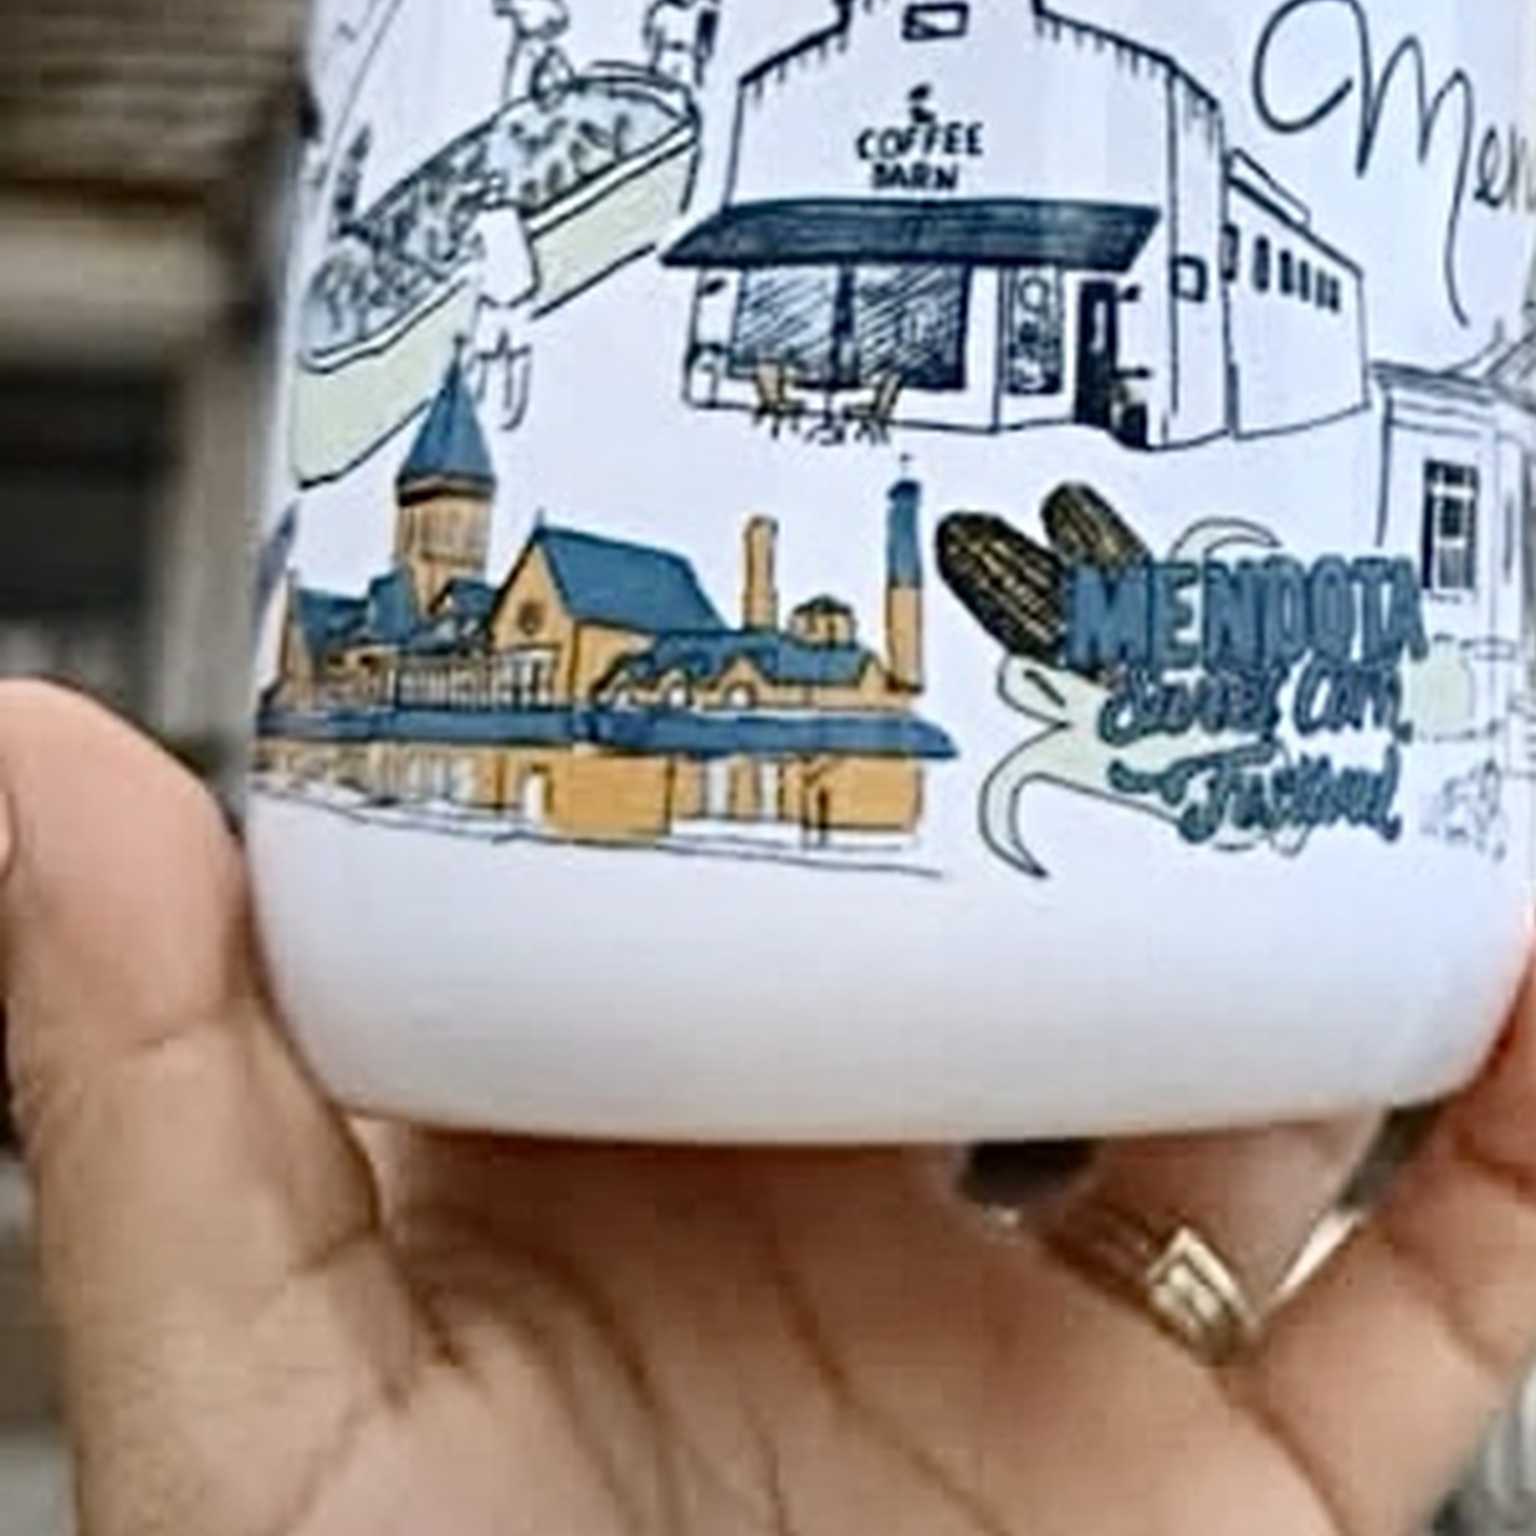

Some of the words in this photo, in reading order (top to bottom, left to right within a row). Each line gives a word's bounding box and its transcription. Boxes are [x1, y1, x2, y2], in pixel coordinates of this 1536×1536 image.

[856, 122, 983, 159] COFFEE
[871, 162, 959, 189] BARN
[1064, 554, 1429, 670] MENDOTA
